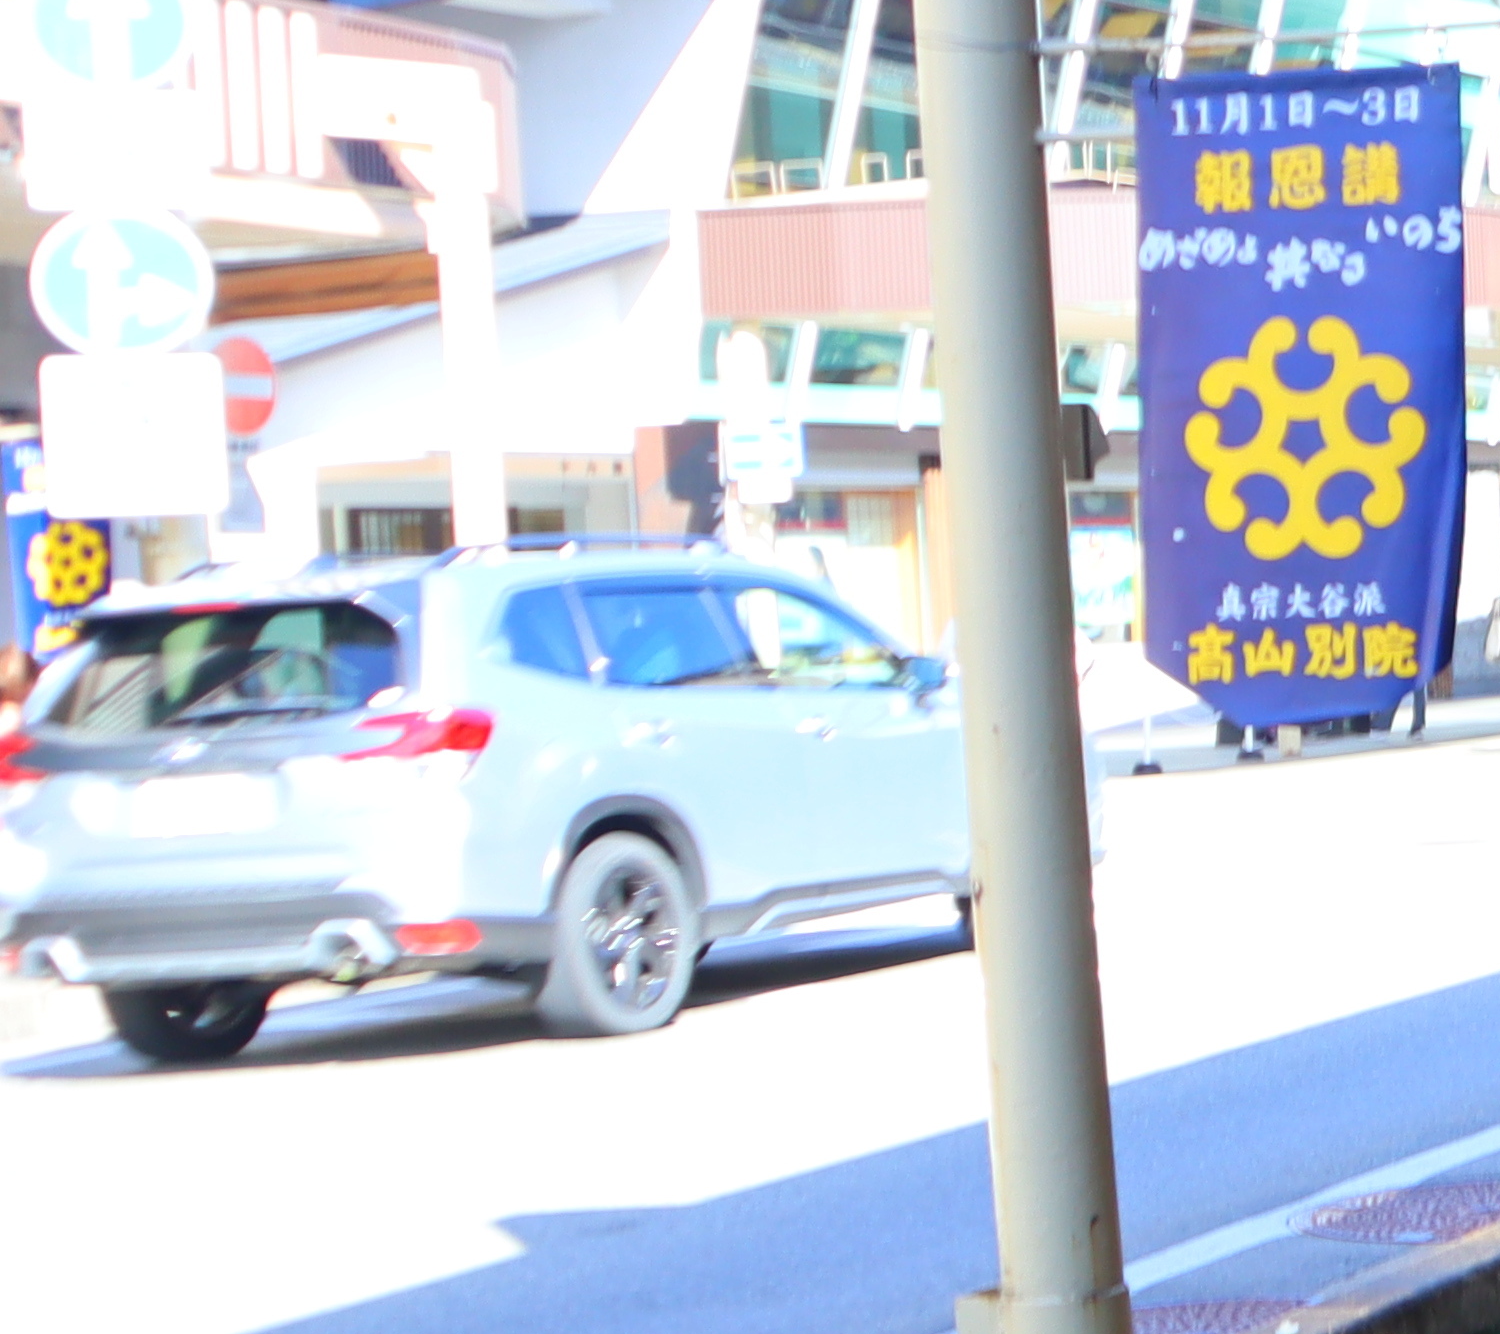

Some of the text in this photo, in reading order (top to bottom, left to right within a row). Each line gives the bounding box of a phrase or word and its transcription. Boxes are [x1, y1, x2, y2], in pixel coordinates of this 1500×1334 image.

[1194, 140, 1400, 215] 報恩講
[1215, 580, 1387, 623] 真宗大谷派
